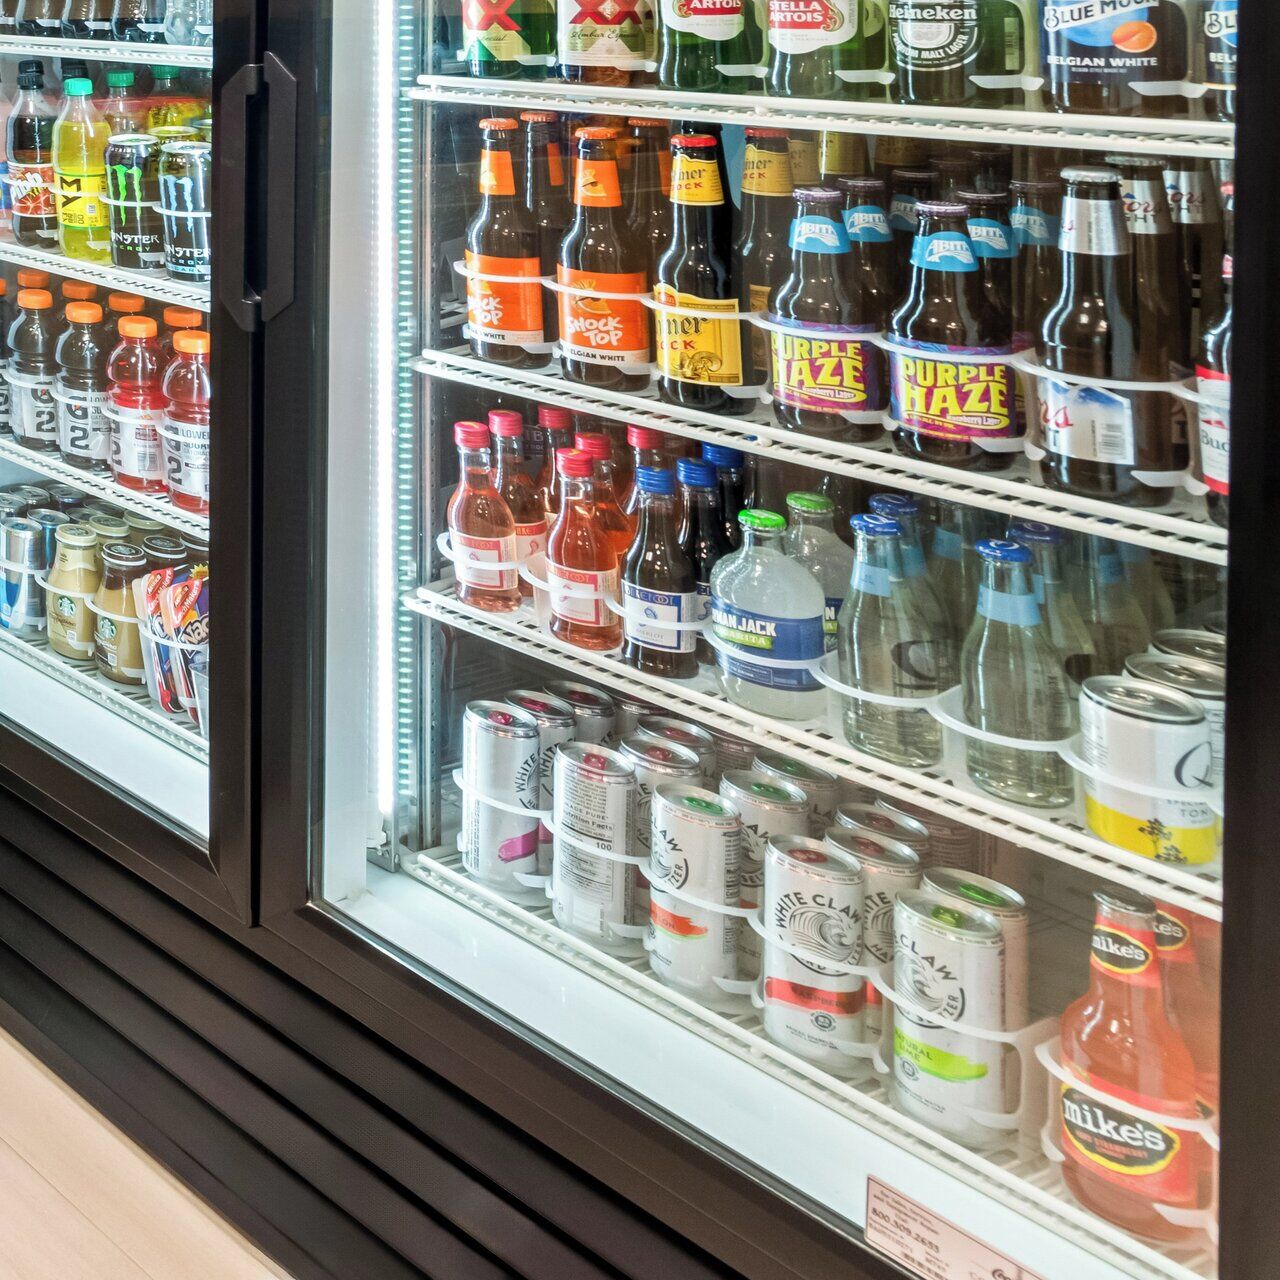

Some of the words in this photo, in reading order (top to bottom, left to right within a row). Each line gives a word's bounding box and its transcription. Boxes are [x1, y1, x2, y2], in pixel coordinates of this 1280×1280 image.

[769, 0, 822, 11] STELLA
[889, 5, 977, 19] Heineken
[769, 10, 824, 23] ARTOIS
[1043, 1, 1095, 30] BLUE
[921, 49, 945, 58] MALT
[945, 35, 969, 54] LAGER
[1047, 56, 1104, 66] BELGIAN
[1109, 55, 1158, 66] WHITE
[849, 213, 886, 231] ABITA
[926, 239, 972, 260] ABITA
[566, 314, 623, 334] SHOCK
[483, 331, 506, 342] WHITE
[587, 329, 623, 347] TOP
[599, 352, 626, 363] WHITE
[904, 363, 1006, 385] PURPLE
[835, 390, 856, 401] Lager
[904, 383, 1009, 415] HAZE
[947, 414, 981, 425] Raspberry
[982, 416, 1001, 427] Lager
[739, 621, 777, 637] JACK
[1174, 740, 1214, 789] Q
[596, 842, 612, 851] 100
[775, 891, 807, 930] WHITE
[811, 893, 862, 924] CLAW
[1092, 935, 1147, 961] mike's
[1063, 1099, 1167, 1149] mike's
